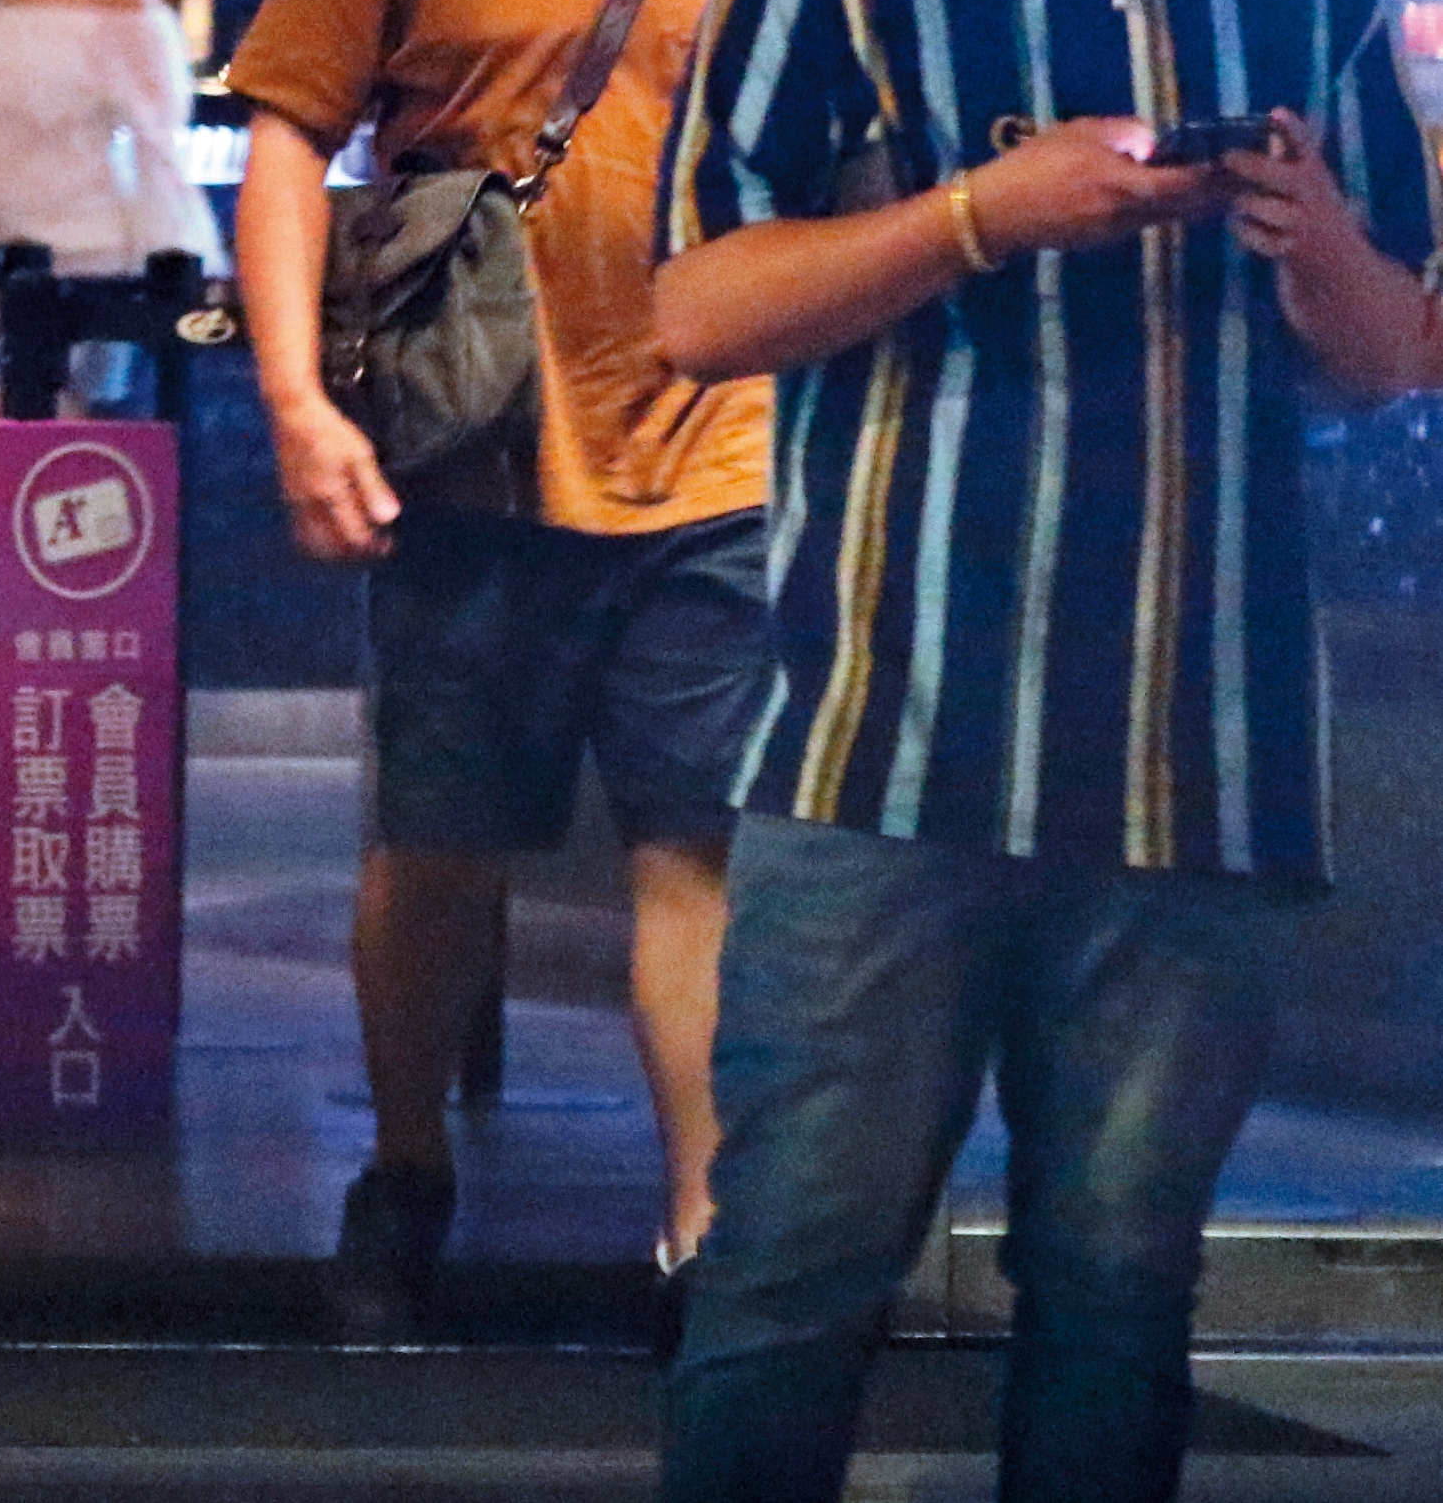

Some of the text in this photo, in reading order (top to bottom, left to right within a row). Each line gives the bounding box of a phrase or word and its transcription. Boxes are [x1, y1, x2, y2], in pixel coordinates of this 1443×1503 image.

[12, 686, 68, 963] 訂票取票
[86, 683, 143, 961] 會員購票
